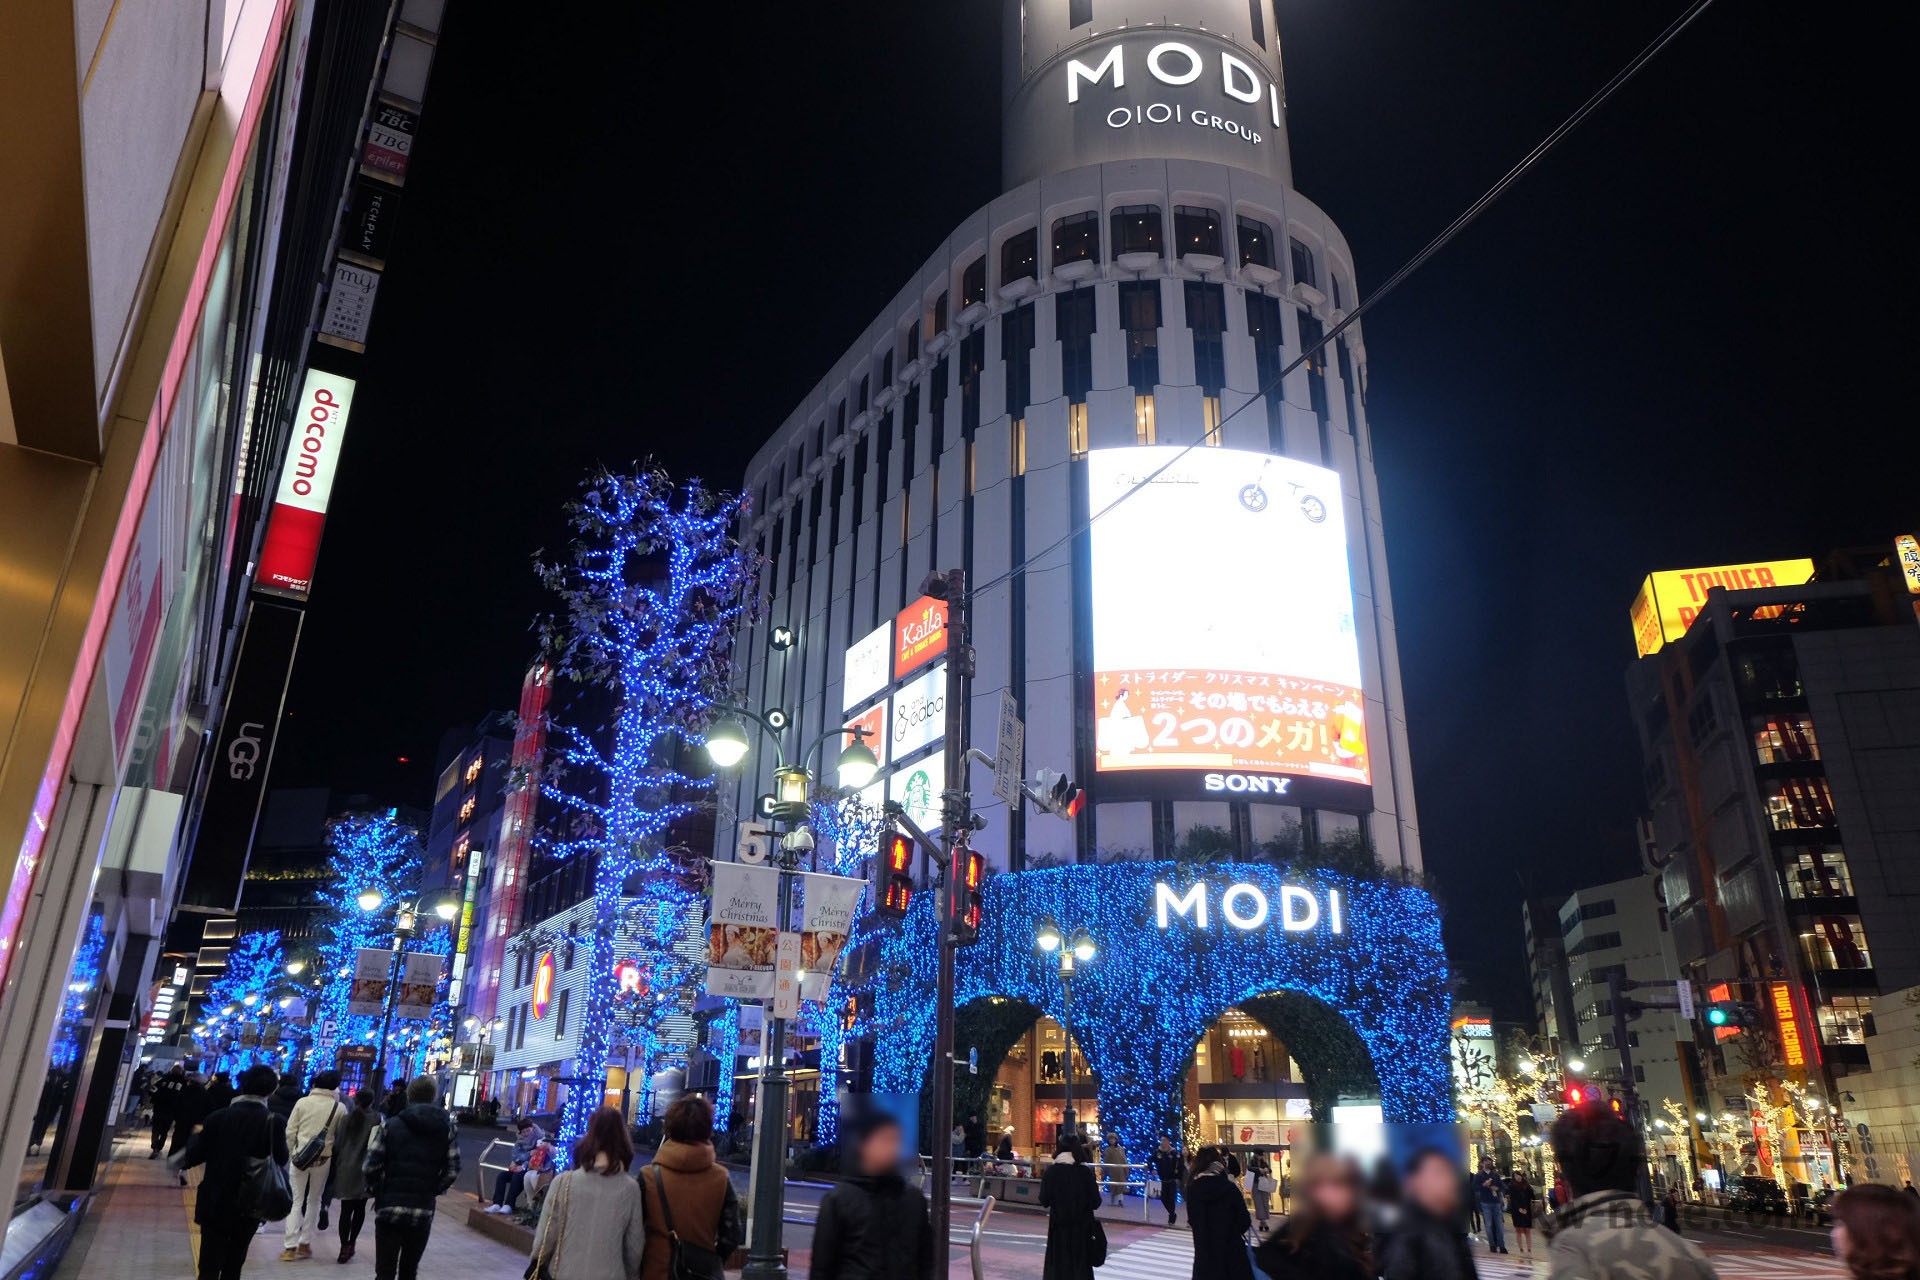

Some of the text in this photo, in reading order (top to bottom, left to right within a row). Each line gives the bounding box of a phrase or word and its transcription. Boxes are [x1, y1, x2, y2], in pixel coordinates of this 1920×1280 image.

[1066, 42, 1280, 128] MODI
[380, 111, 413, 131] TBC
[1191, 110, 1262, 144] GROUP
[374, 131, 409, 151] TBC
[361, 195, 382, 250] TECH PLAY
[292, 388, 340, 496] docomo
[273, 573, 308, 586] ドコモショップ
[901, 606, 942, 651] Kaila
[1119, 671, 1345, 697] ストライダー クリスマス キャンペーン
[1190, 690, 1329, 720] その場でもらえる
[227, 721, 264, 780] UGG
[1204, 773, 1292, 794] SONY
[738, 821, 767, 865] 5
[719, 908, 769, 923] Christmas
[729, 897, 763, 912] Merry
[819, 905, 850, 917] Merry
[1156, 882, 1342, 934] MODI
[778, 938, 794, 1011] 公園通り
[322, 1020, 337, 1037] P
[1773, 985, 1804, 1066] TOWER RECORDS
